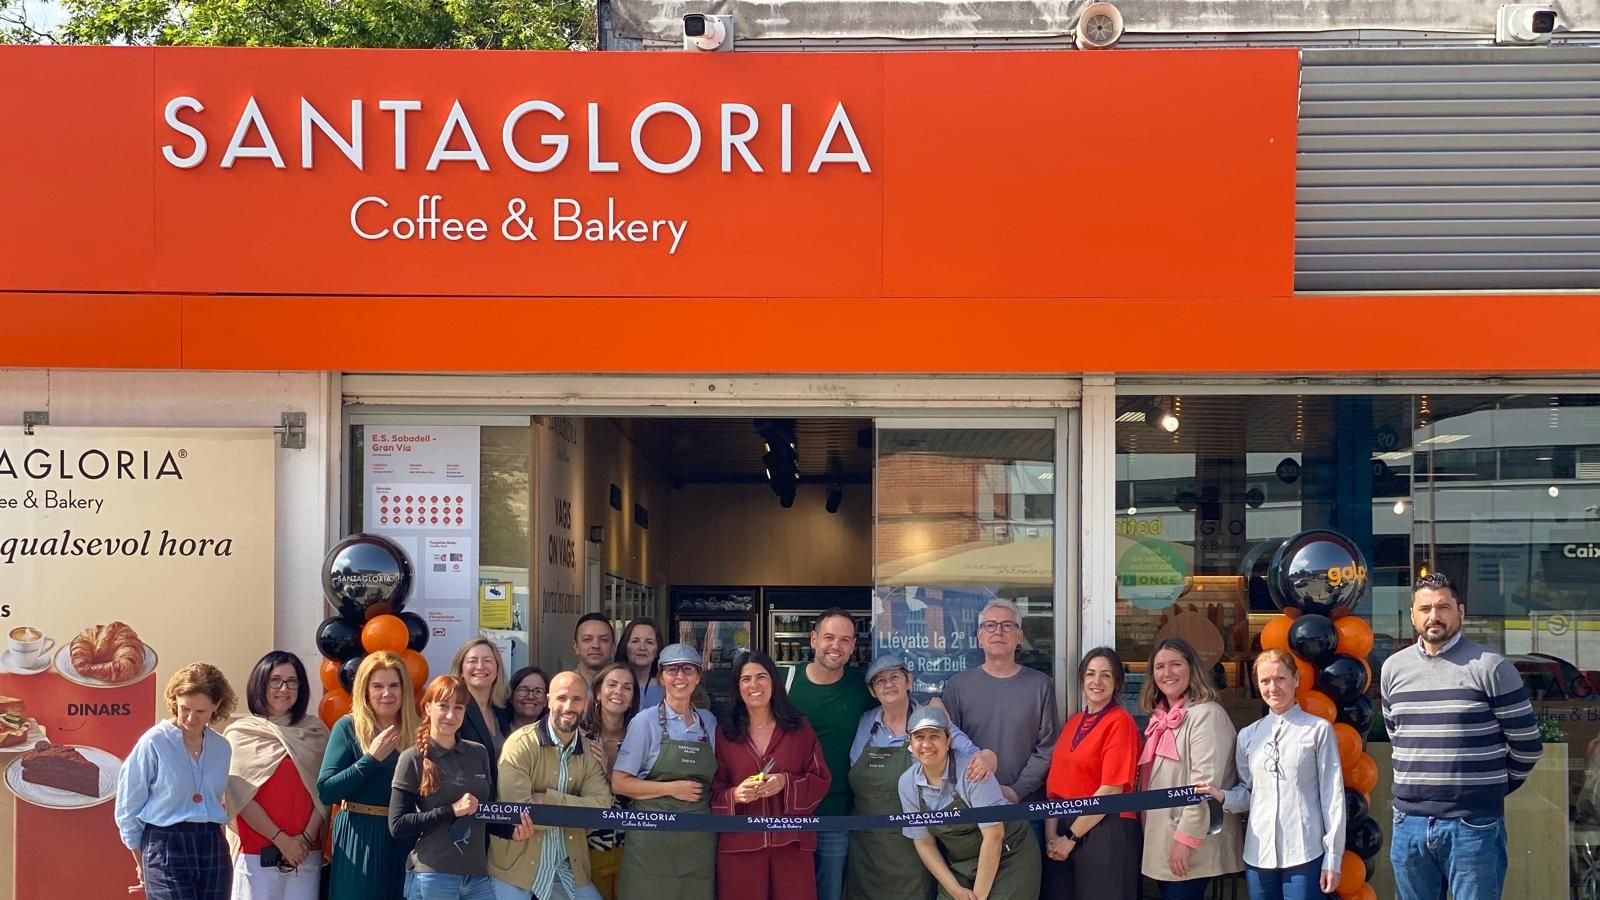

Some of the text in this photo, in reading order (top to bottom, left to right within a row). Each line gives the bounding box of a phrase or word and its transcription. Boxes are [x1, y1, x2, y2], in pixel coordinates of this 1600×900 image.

[161, 95, 872, 174] SANTAGLORIA
[350, 194, 688, 254] Coffee & Bakery
[372, 434, 389, 442] E.S.
[392, 434, 431, 442] Sabadell
[372, 443, 394, 452] Gran
[23, 489, 39, 509] &
[45, 489, 104, 514] Bakery
[0, 529, 233, 564] qualsevol hora
[1139, 575, 1177, 586] ONCE
[880, 631, 929, 649] Llévate
[934, 631, 946, 649] la
[918, 657, 940, 672] Red
[944, 656, 966, 672] Bull
[67, 703, 131, 716] DINARS
[478, 803, 531, 814] TAGLORIA
[1029, 798, 1100, 812] SANTAGLORIA
[602, 810, 677, 822] SANTAGLORIA
[747, 816, 820, 824] SANTAGLORIA
[889, 810, 961, 821] SANTAGLORIA
